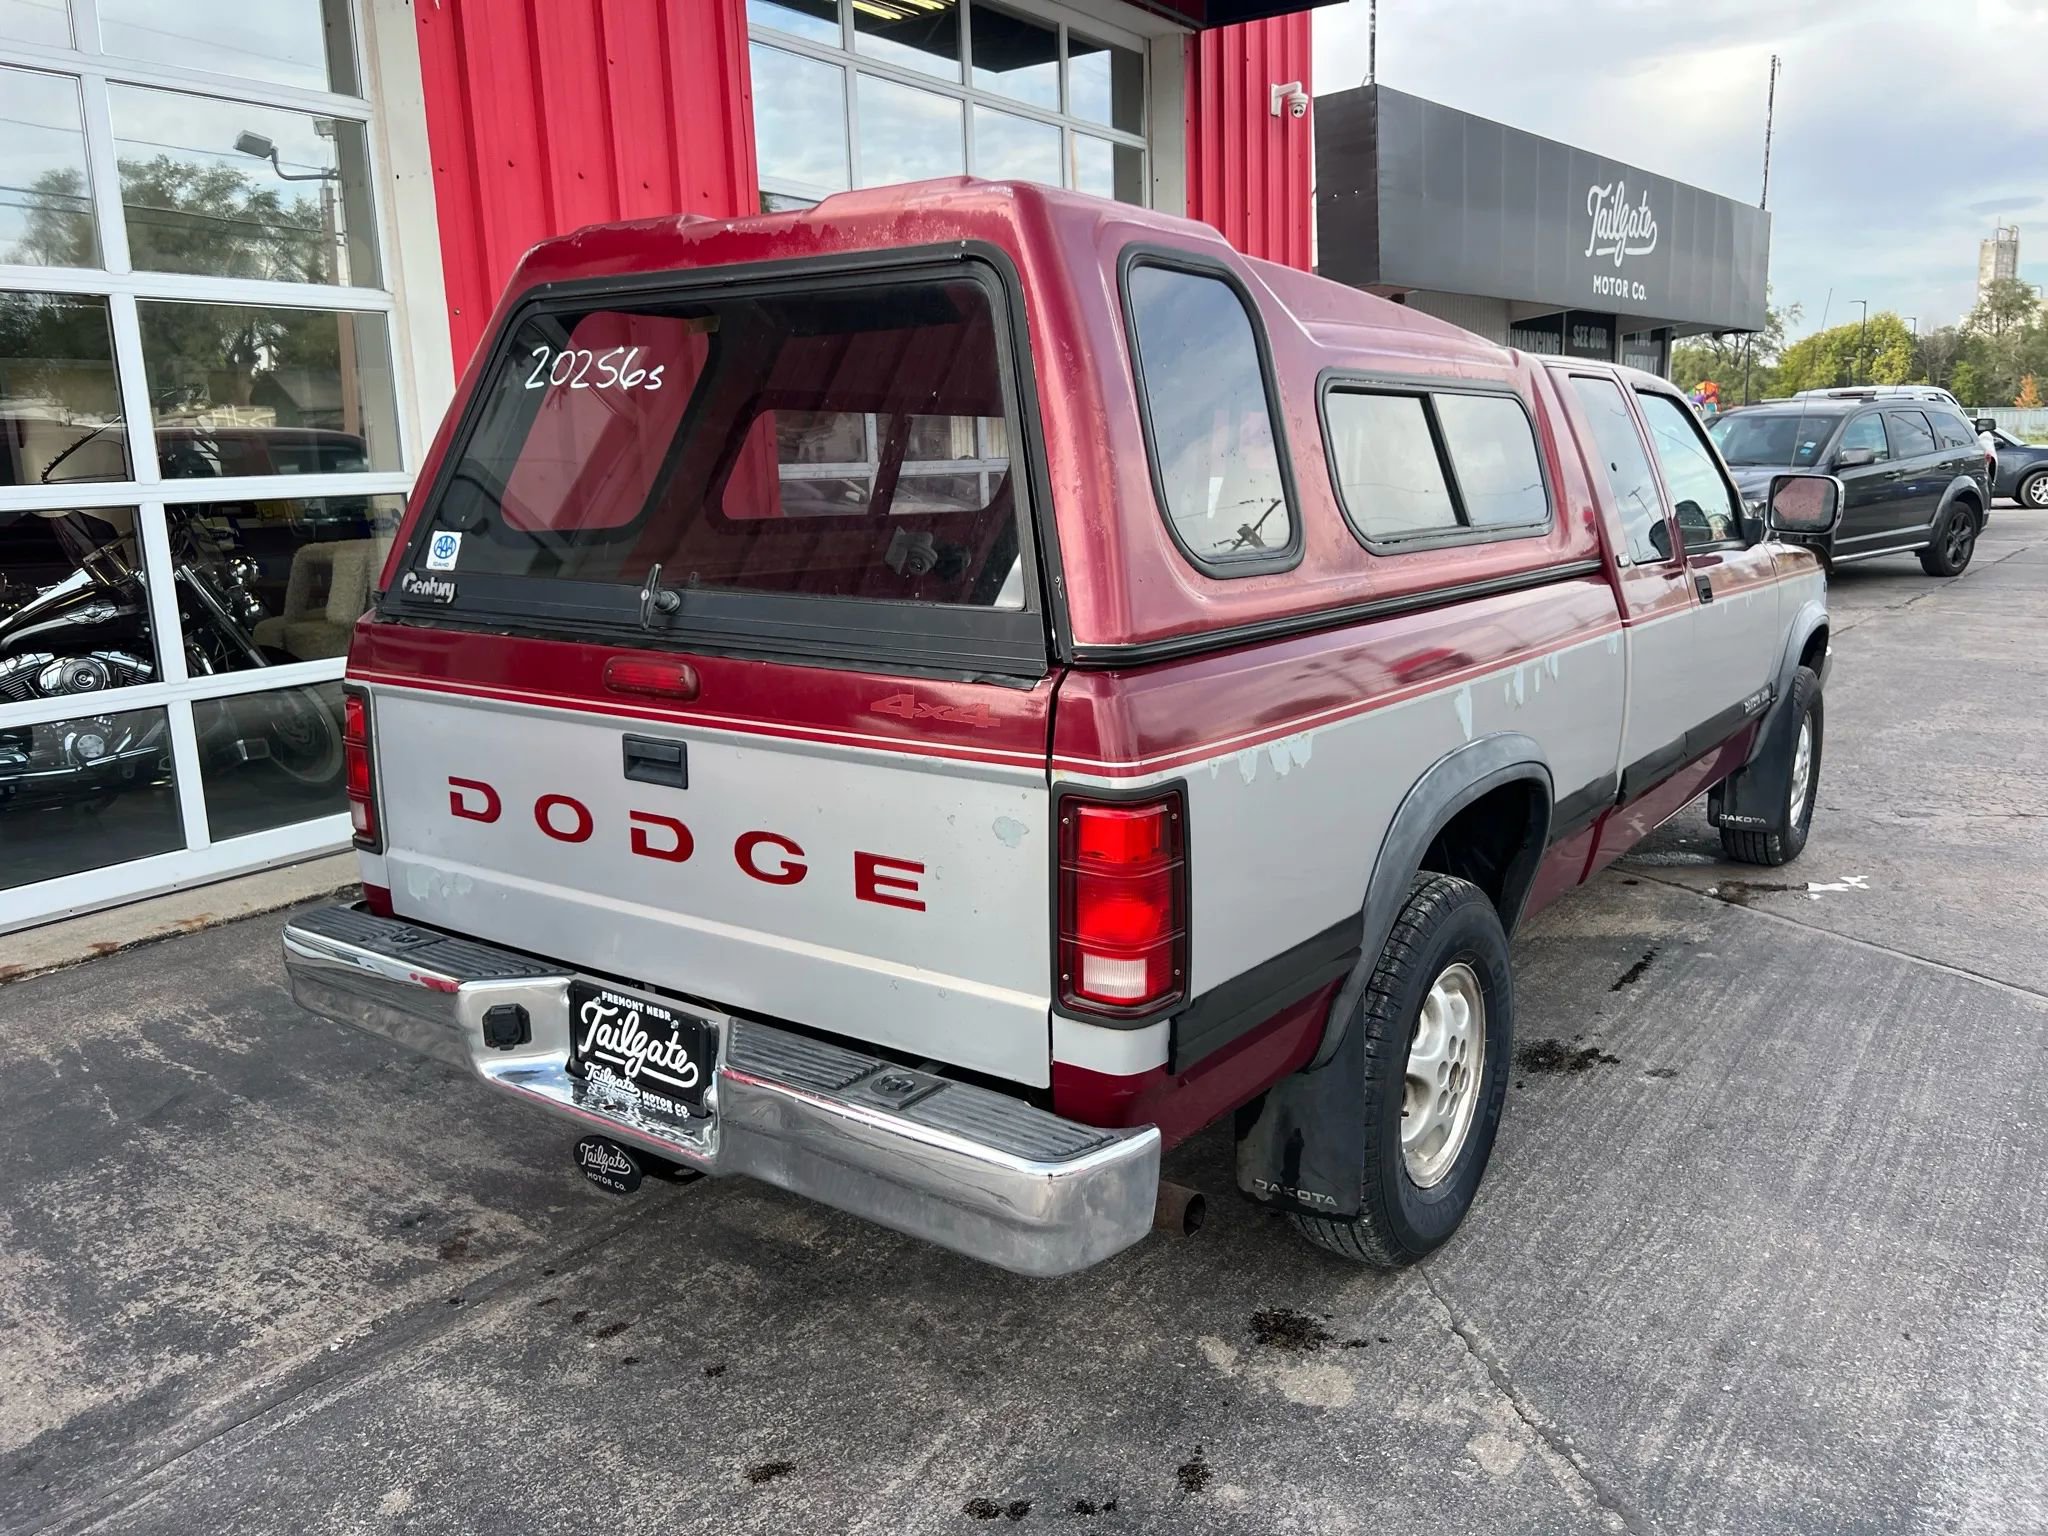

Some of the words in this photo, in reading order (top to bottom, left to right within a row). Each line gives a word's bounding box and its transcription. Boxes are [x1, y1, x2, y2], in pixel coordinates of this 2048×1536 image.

[1585, 181, 1657, 267] Tailgate
[1593, 275, 1628, 298] MOTOR
[1573, 325, 1589, 348] SEE
[1590, 327, 1607, 349] OUR
[402, 572, 455, 603] Century
[870, 693, 1000, 728] 4x4
[1719, 813, 1767, 825] DAKOTA
[448, 775, 926, 912] DODGE
[602, 991, 644, 1012] FREMONT
[646, 1005, 671, 1021] NEBR
[578, 1001, 699, 1088] Tailgate
[584, 1061, 641, 1097] Tailgate
[642, 1090, 673, 1111] MOTOR
[580, 1142, 631, 1174] Tailgate
[587, 1171, 612, 1186] MOTOR
[1255, 1178, 1338, 1207] DAKOTA
